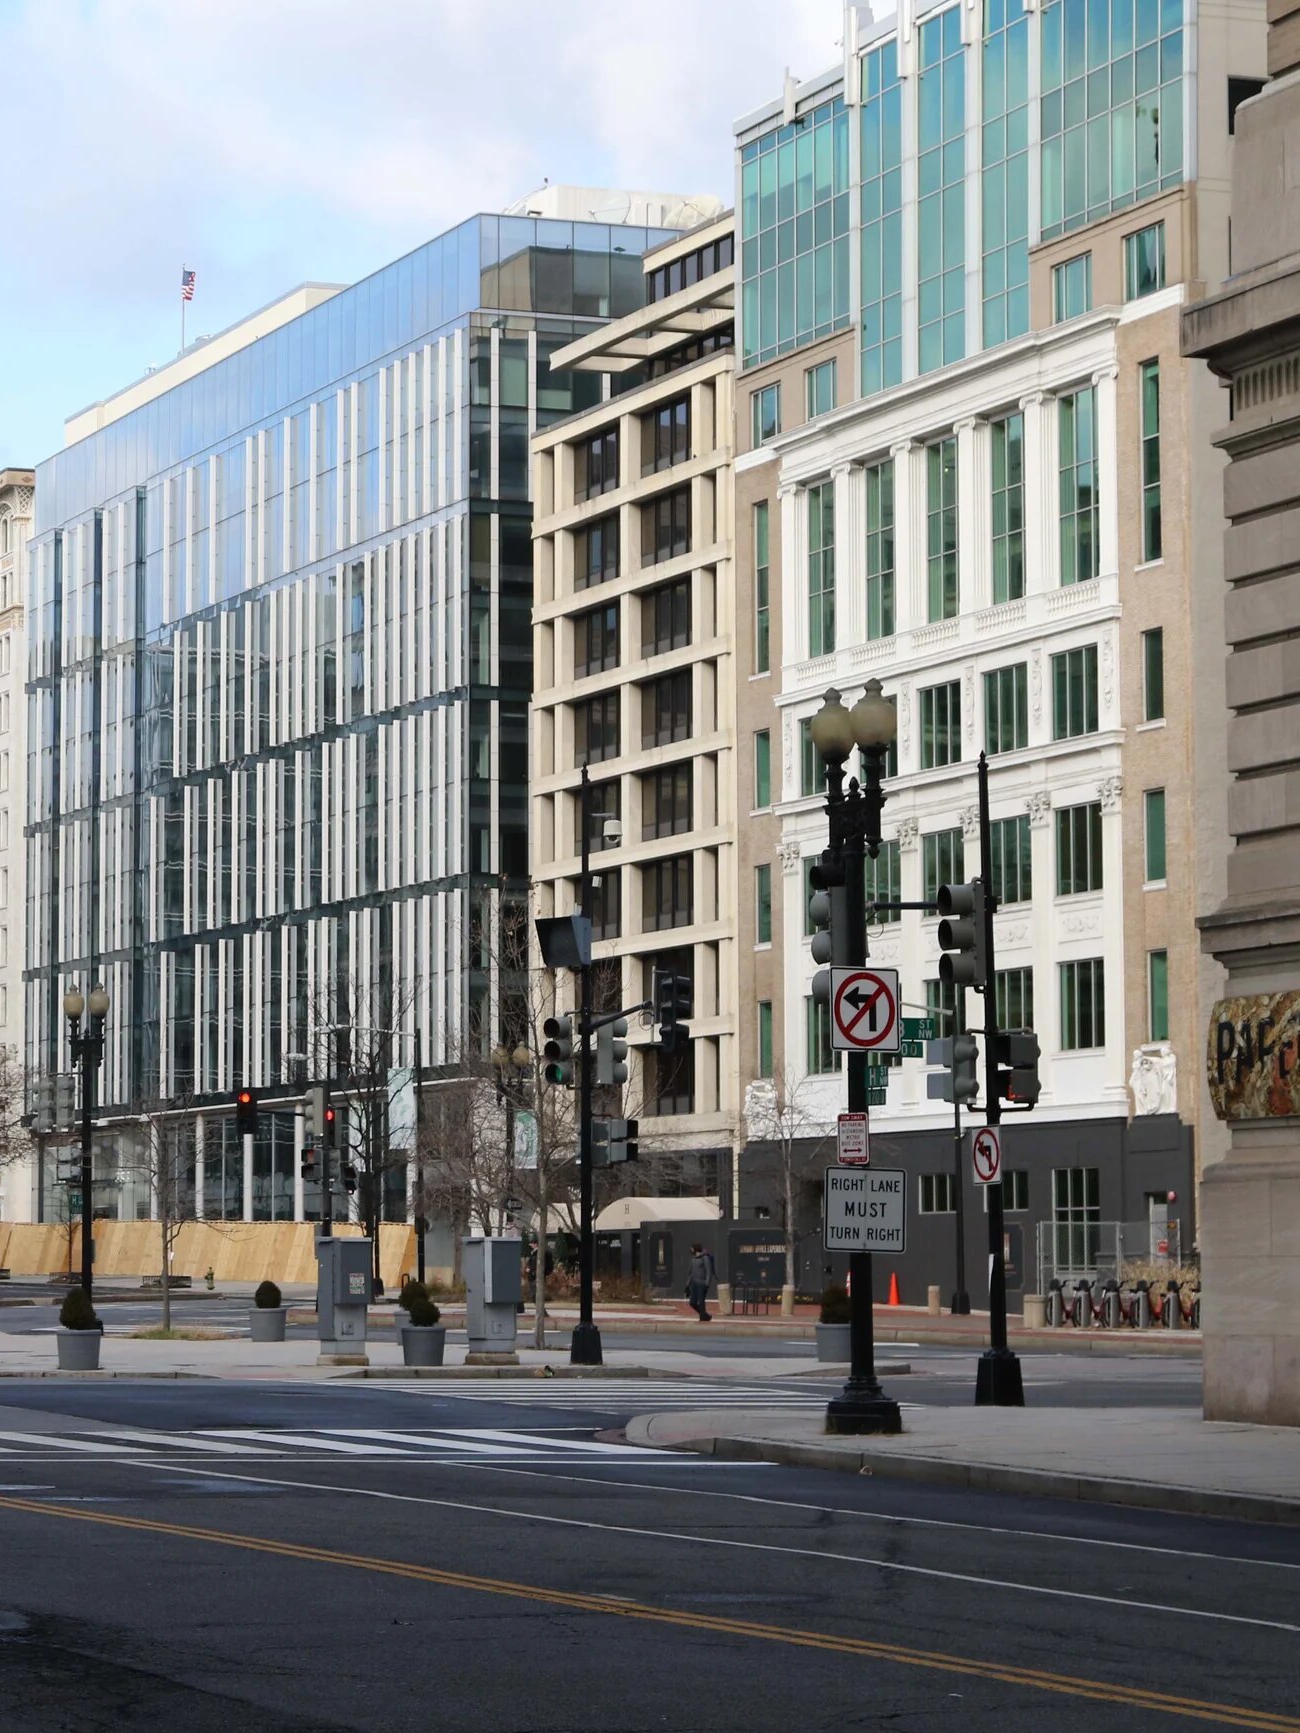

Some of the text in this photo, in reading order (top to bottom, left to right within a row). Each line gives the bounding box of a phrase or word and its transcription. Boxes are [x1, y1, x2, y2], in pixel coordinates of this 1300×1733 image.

[919, 1020, 931, 1029] ST
[918, 1029, 933, 1039] NW
[869, 1067, 877, 1086] H
[831, 1178, 900, 1193] RIGHT LANE
[845, 1201, 887, 1218] MUST
[830, 1226, 901, 1242] TURN RIGHT
